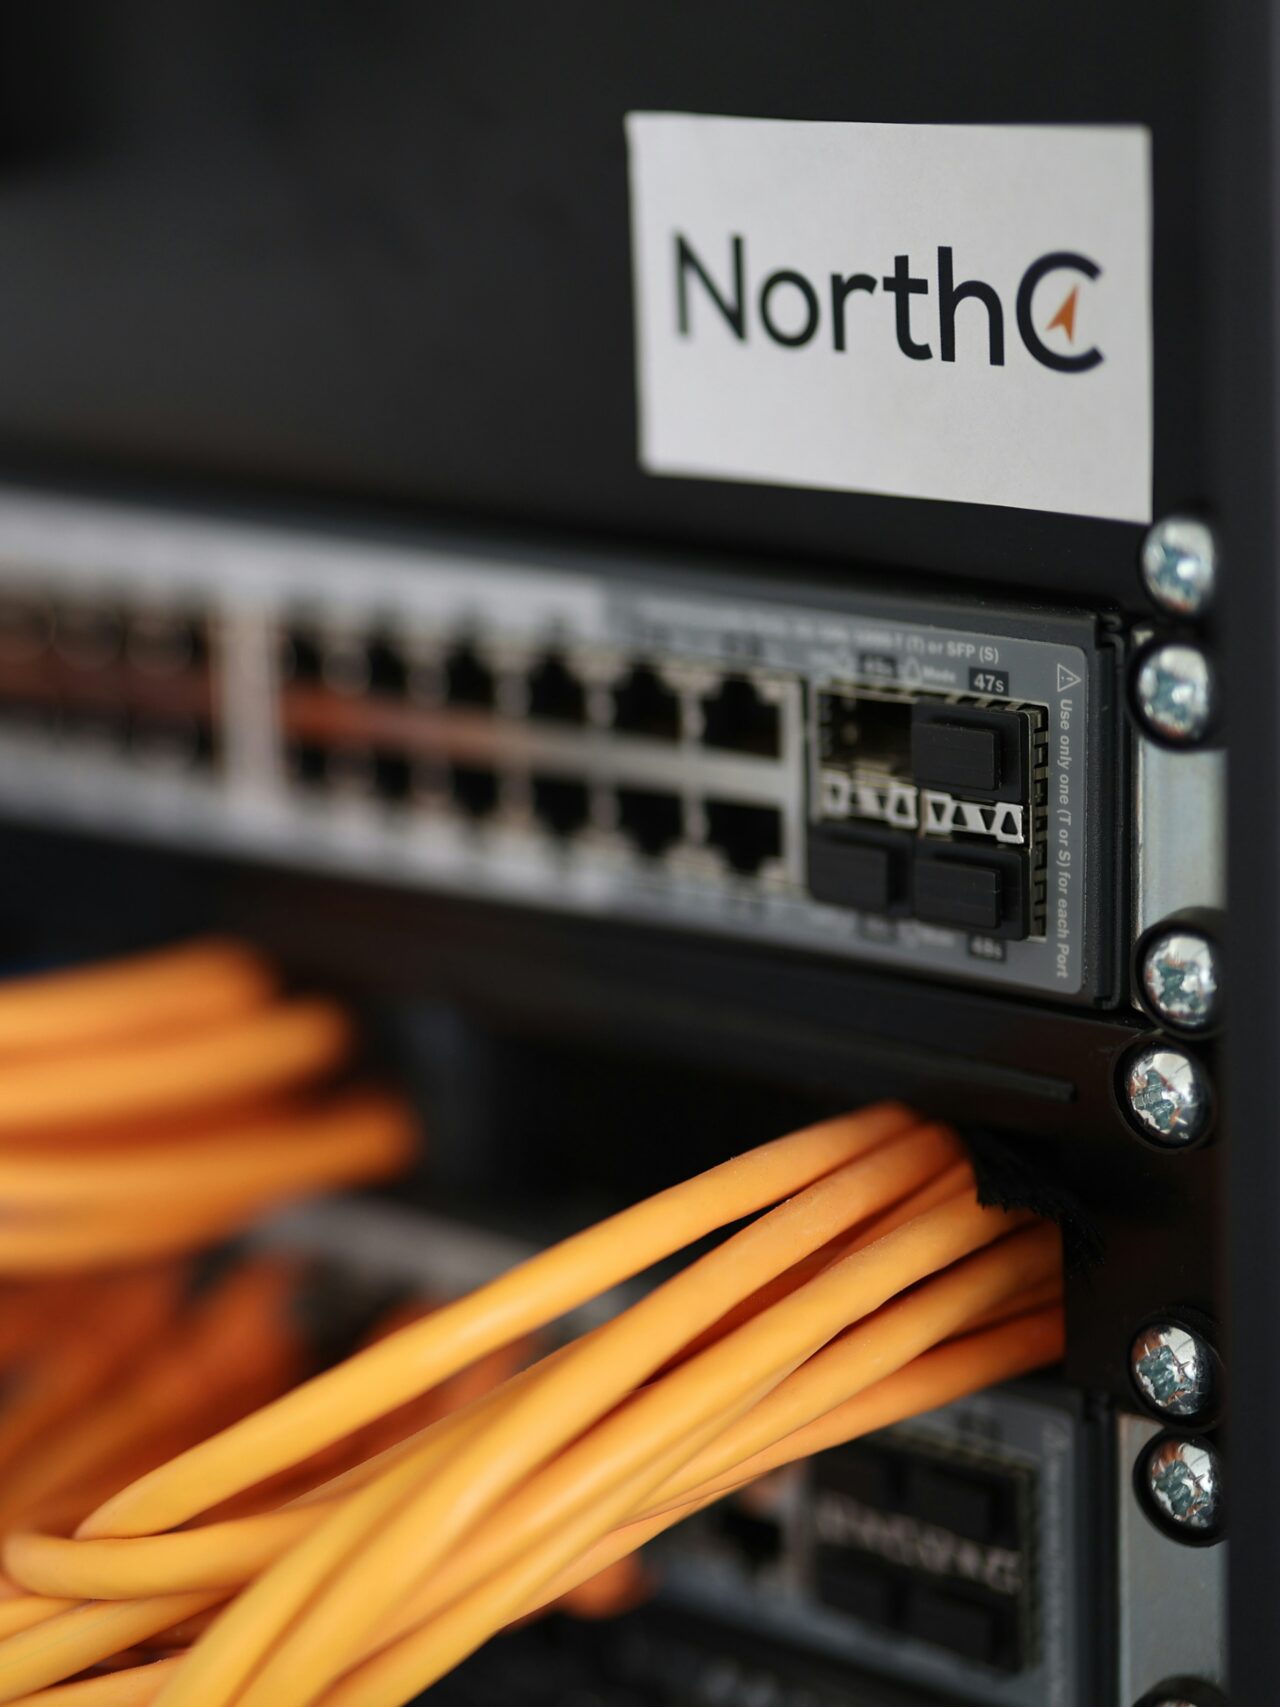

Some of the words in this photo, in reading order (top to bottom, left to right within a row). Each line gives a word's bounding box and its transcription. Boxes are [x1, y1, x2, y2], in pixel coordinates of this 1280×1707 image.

[674, 229, 1104, 374] NorthC
[928, 640, 943, 656] or
[946, 639, 976, 659] SFP
[979, 645, 1000, 665] (S)
[973, 672, 1005, 693] 47s
[1060, 698, 1072, 730] Use
[1057, 735, 1072, 770] only
[1060, 774, 1069, 805] one
[1057, 809, 1071, 826] (T
[1059, 829, 1068, 846] or
[1056, 850, 1071, 867] S)
[1058, 871, 1071, 894] for
[1057, 898, 1070, 939] each
[1057, 943, 1070, 978] Port
